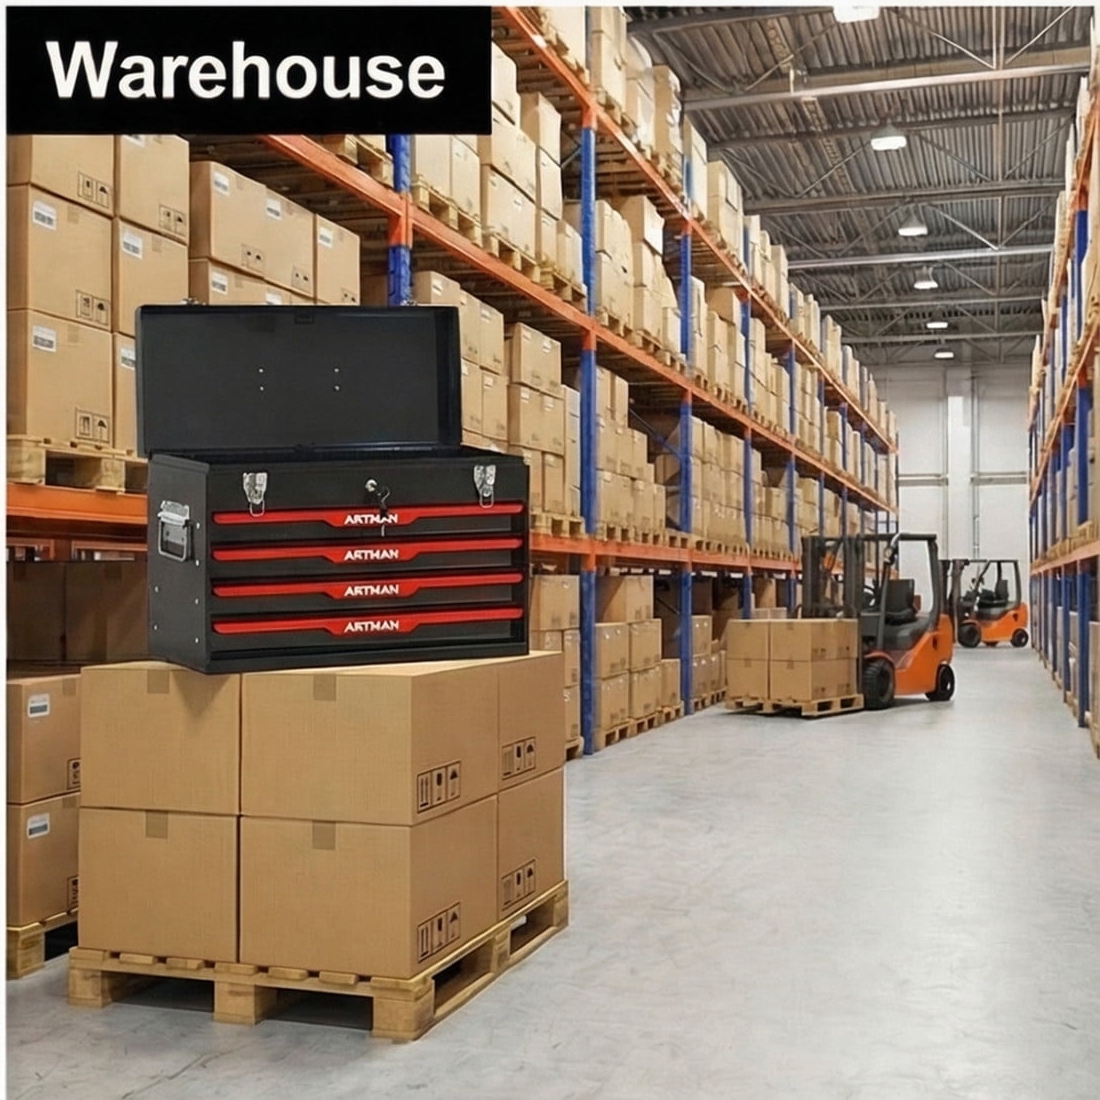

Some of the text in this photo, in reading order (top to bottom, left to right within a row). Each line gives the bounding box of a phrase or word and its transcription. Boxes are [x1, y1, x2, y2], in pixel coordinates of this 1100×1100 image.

[343, 548, 400, 562] ARTMAN
[343, 583, 400, 598] ARTMAN
[343, 619, 400, 634] ARTMAN
